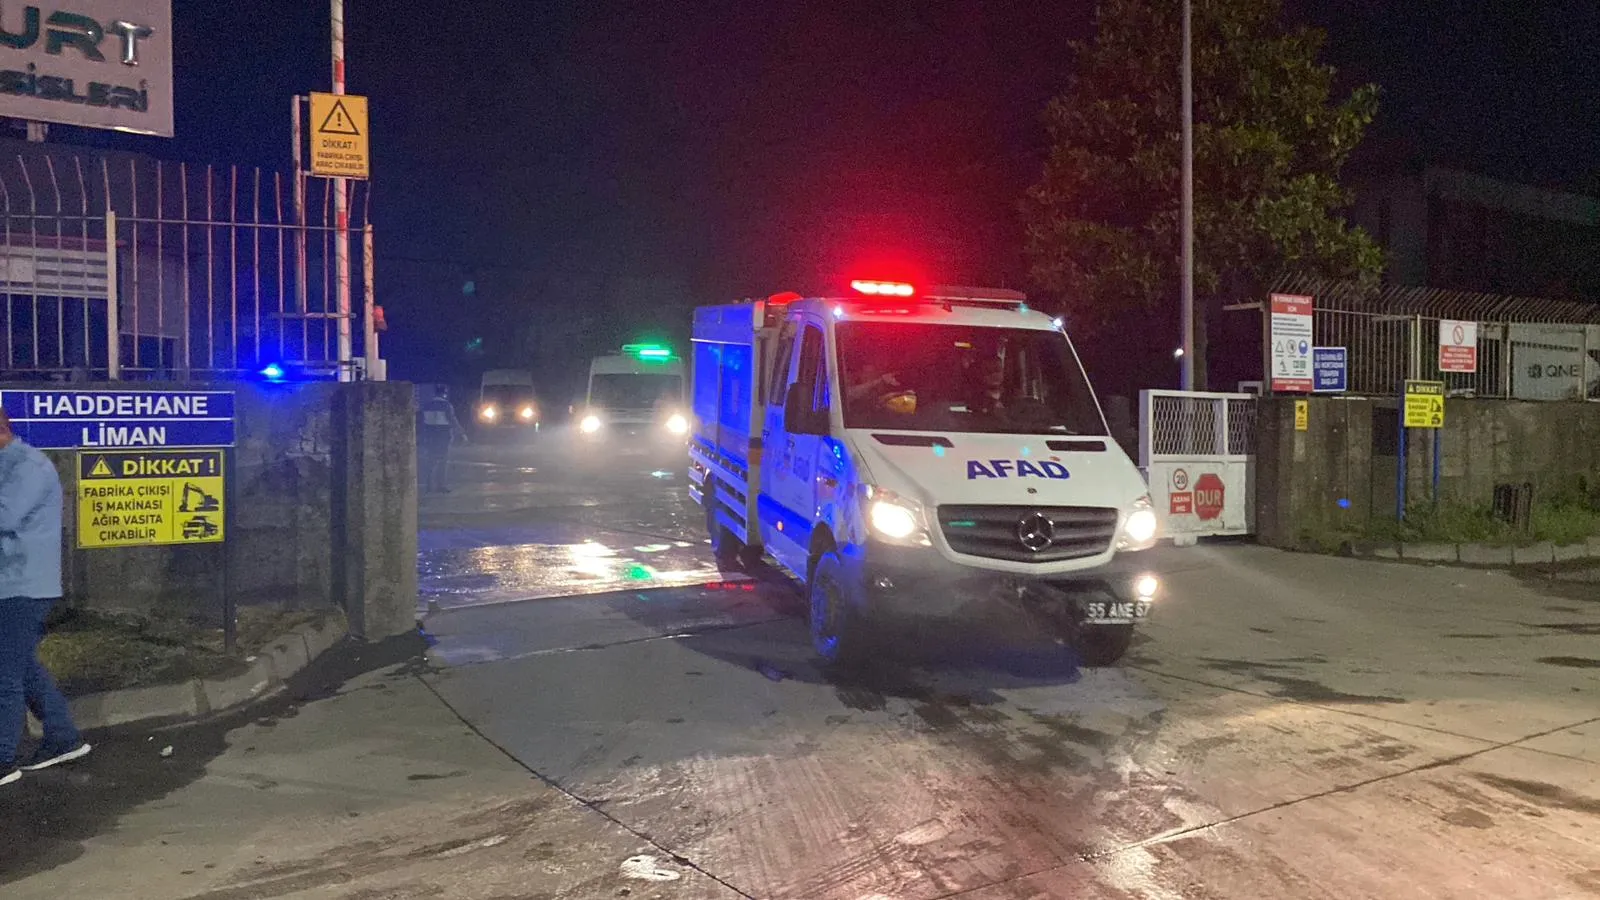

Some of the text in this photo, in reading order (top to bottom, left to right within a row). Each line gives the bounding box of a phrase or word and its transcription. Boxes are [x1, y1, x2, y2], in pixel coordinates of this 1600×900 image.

[33, 395, 208, 416] HADDEHANE
[82, 422, 166, 446] LİMAN
[122, 457, 215, 476] DİKKAT !
[966, 460, 1070, 480] AFAD
[1176, 474, 1185, 485] 20
[84, 484, 170, 498] FABRİKA ÇIKIŞI
[1196, 489, 1222, 506] DUR
[92, 499, 163, 513] İŞ MAKİNASI
[92, 514, 163, 527] AĞIR VASITA
[99, 528, 156, 542] ÇIKABİLİR
